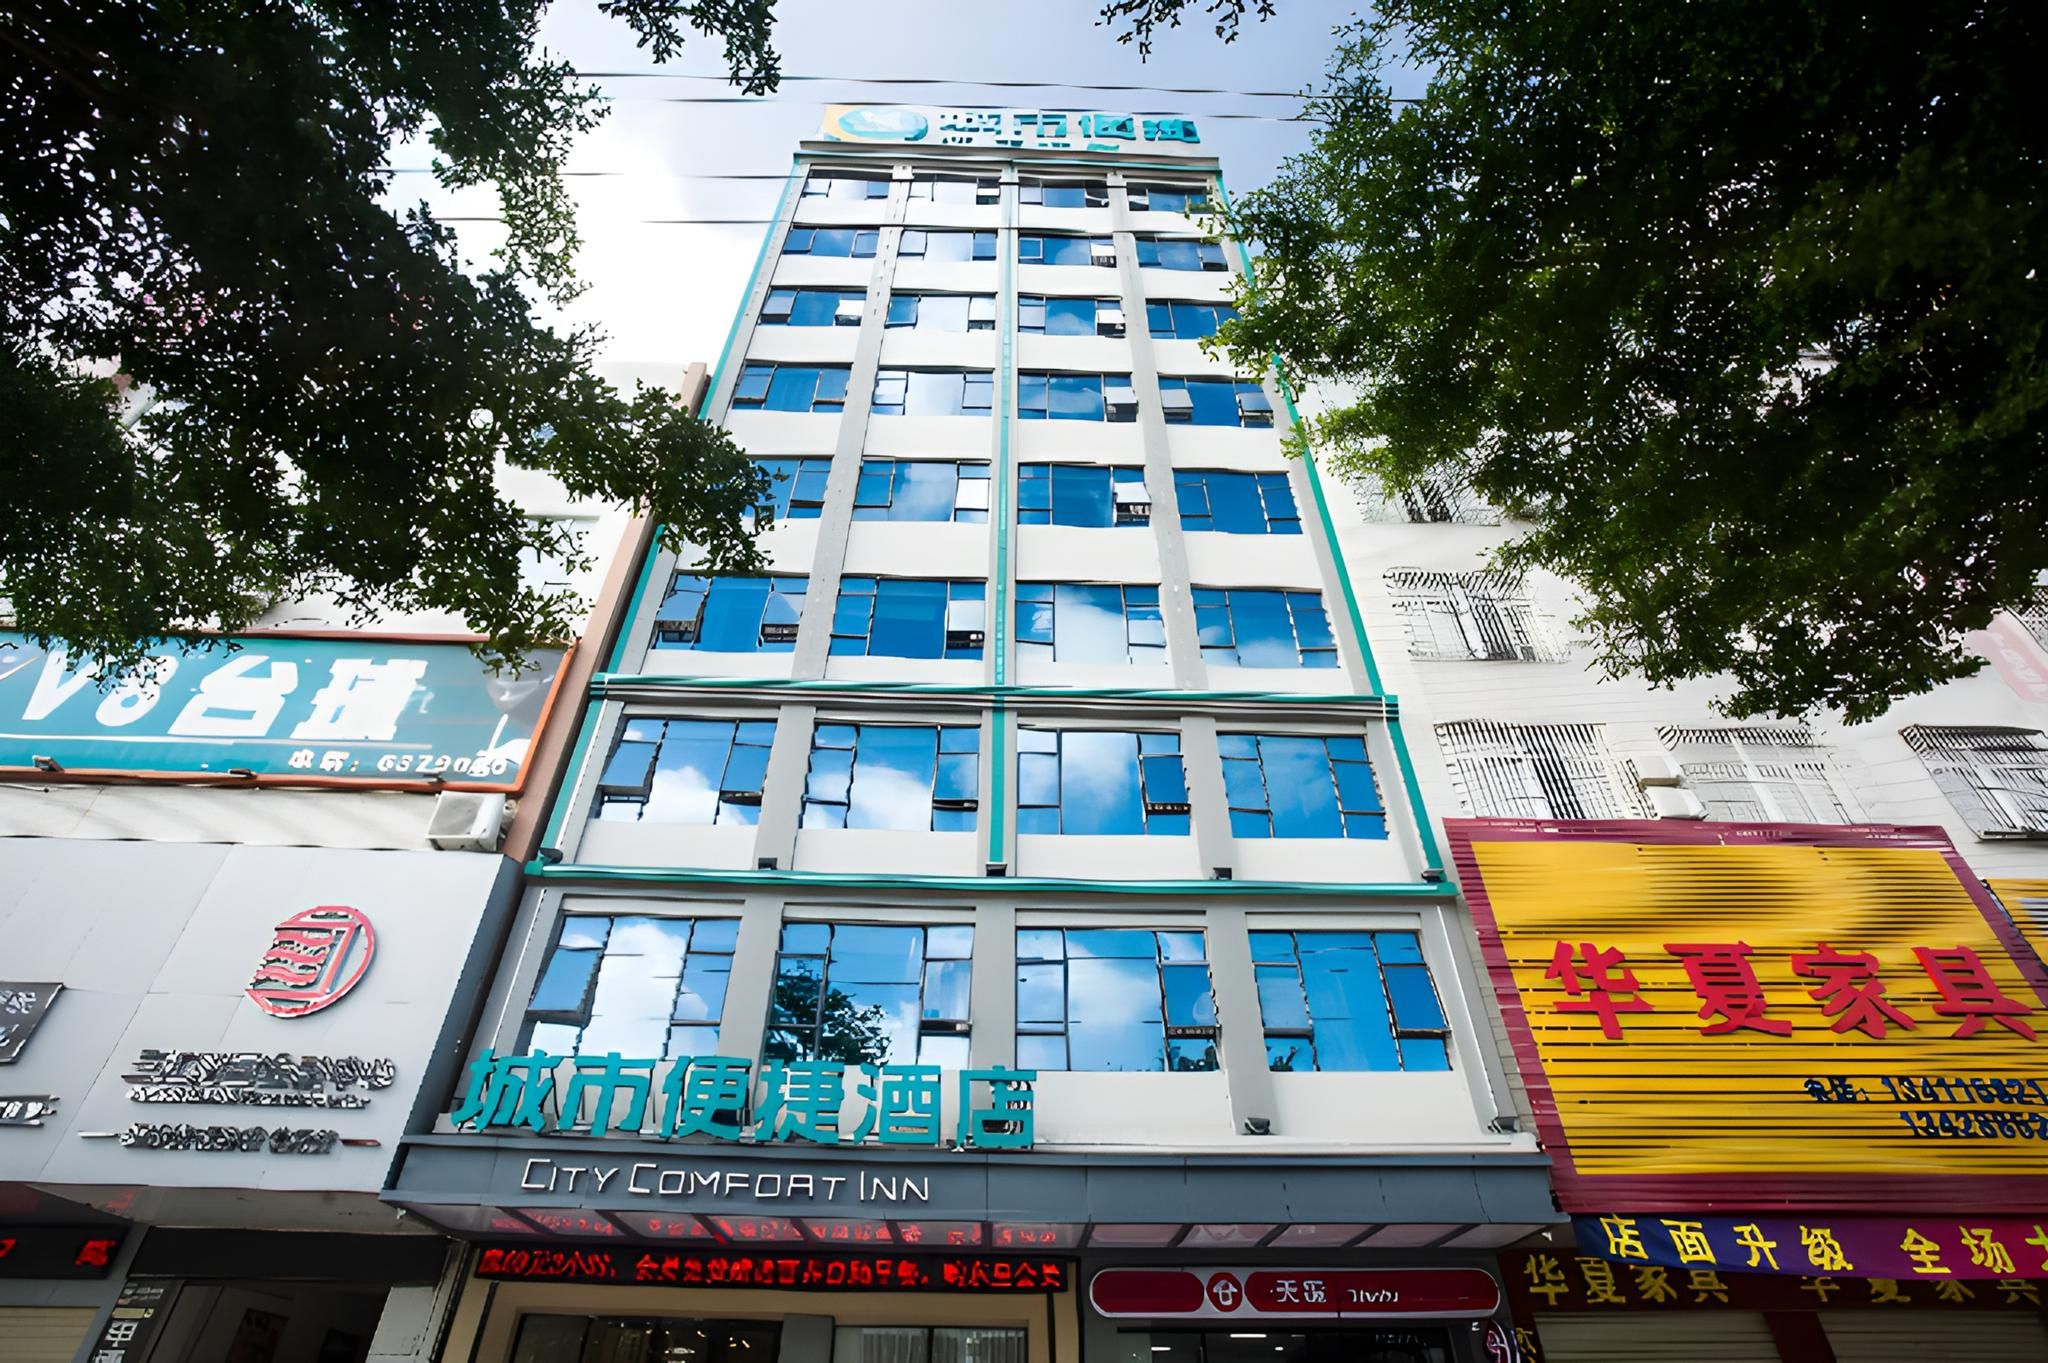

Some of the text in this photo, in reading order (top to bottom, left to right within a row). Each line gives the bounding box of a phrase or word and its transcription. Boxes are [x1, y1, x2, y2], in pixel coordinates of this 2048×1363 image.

[1544, 941, 2037, 1041] 华夏家具
[450, 1048, 1037, 1148] 城市便捷酒店
[521, 1158, 619, 1193] CITY
[860, 1170, 930, 1201] INN
